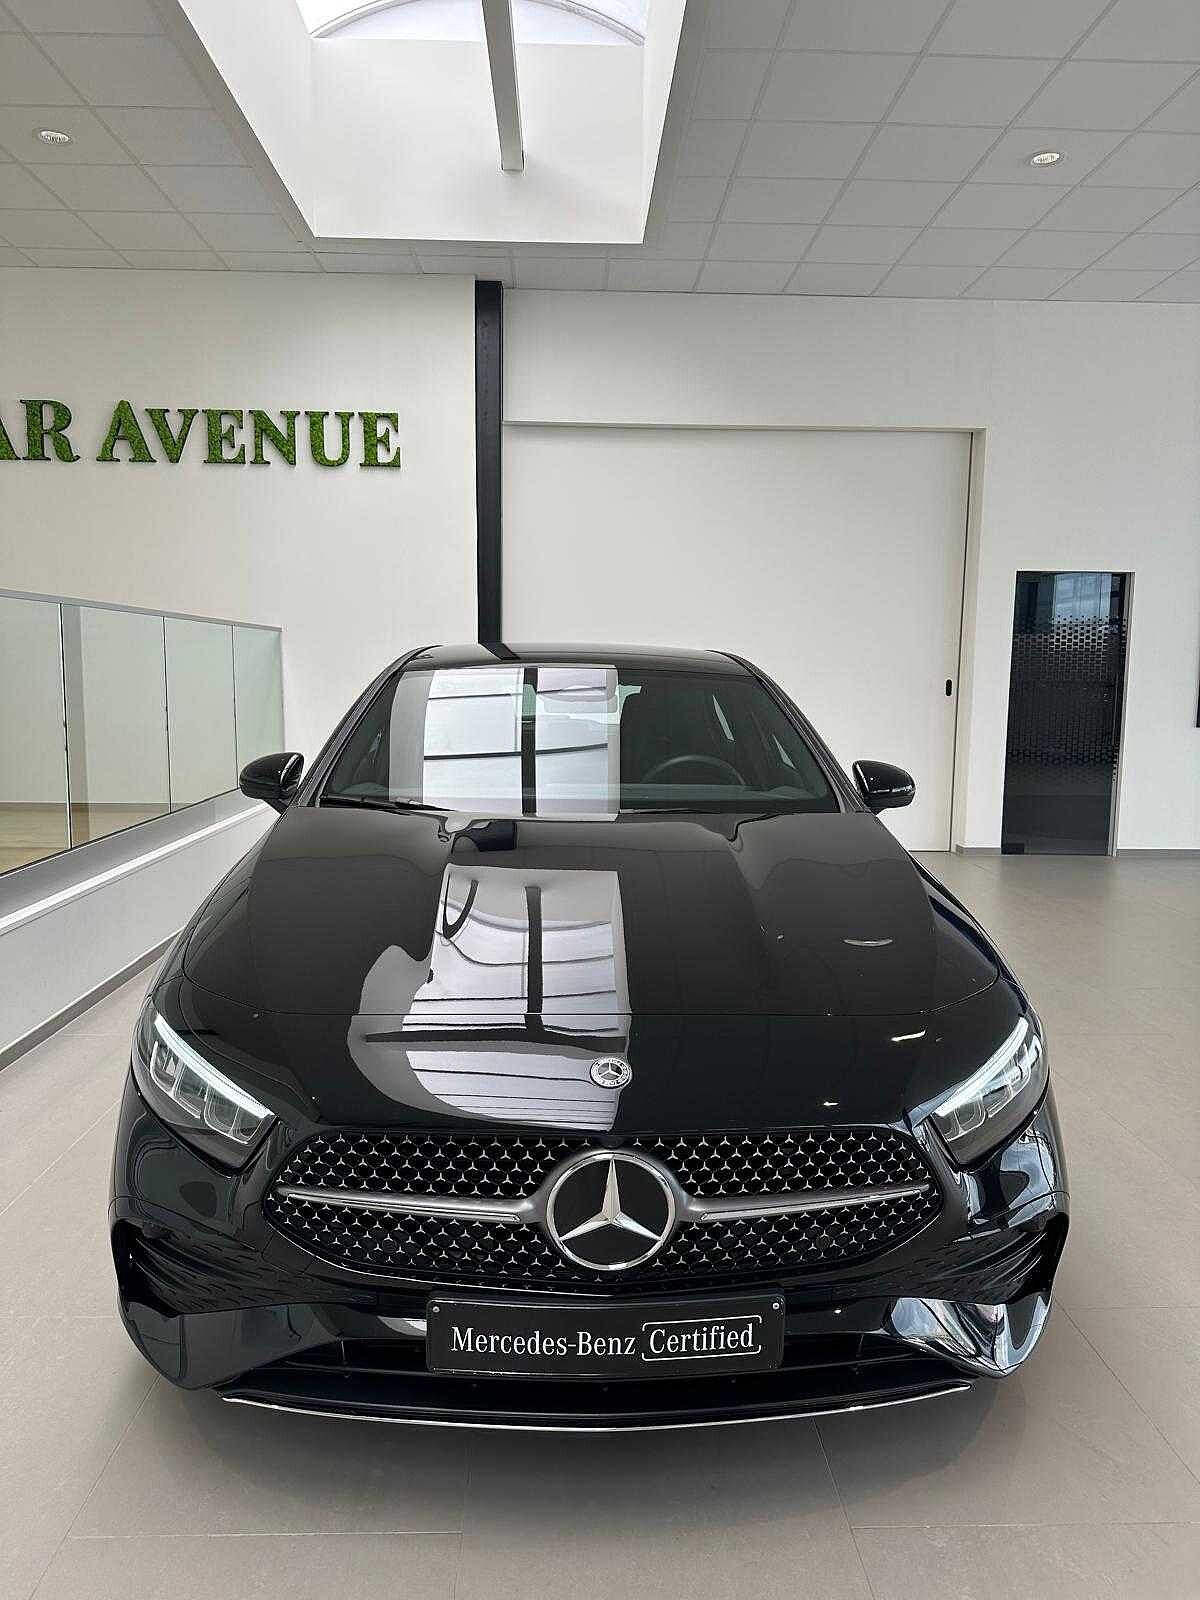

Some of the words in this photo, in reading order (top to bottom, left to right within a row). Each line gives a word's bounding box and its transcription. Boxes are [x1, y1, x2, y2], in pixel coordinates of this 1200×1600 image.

[97, 400, 401, 468] AVENUE
[451, 1327, 636, 1356] Mercedes-Benz
[649, 1323, 754, 1354] Certified
